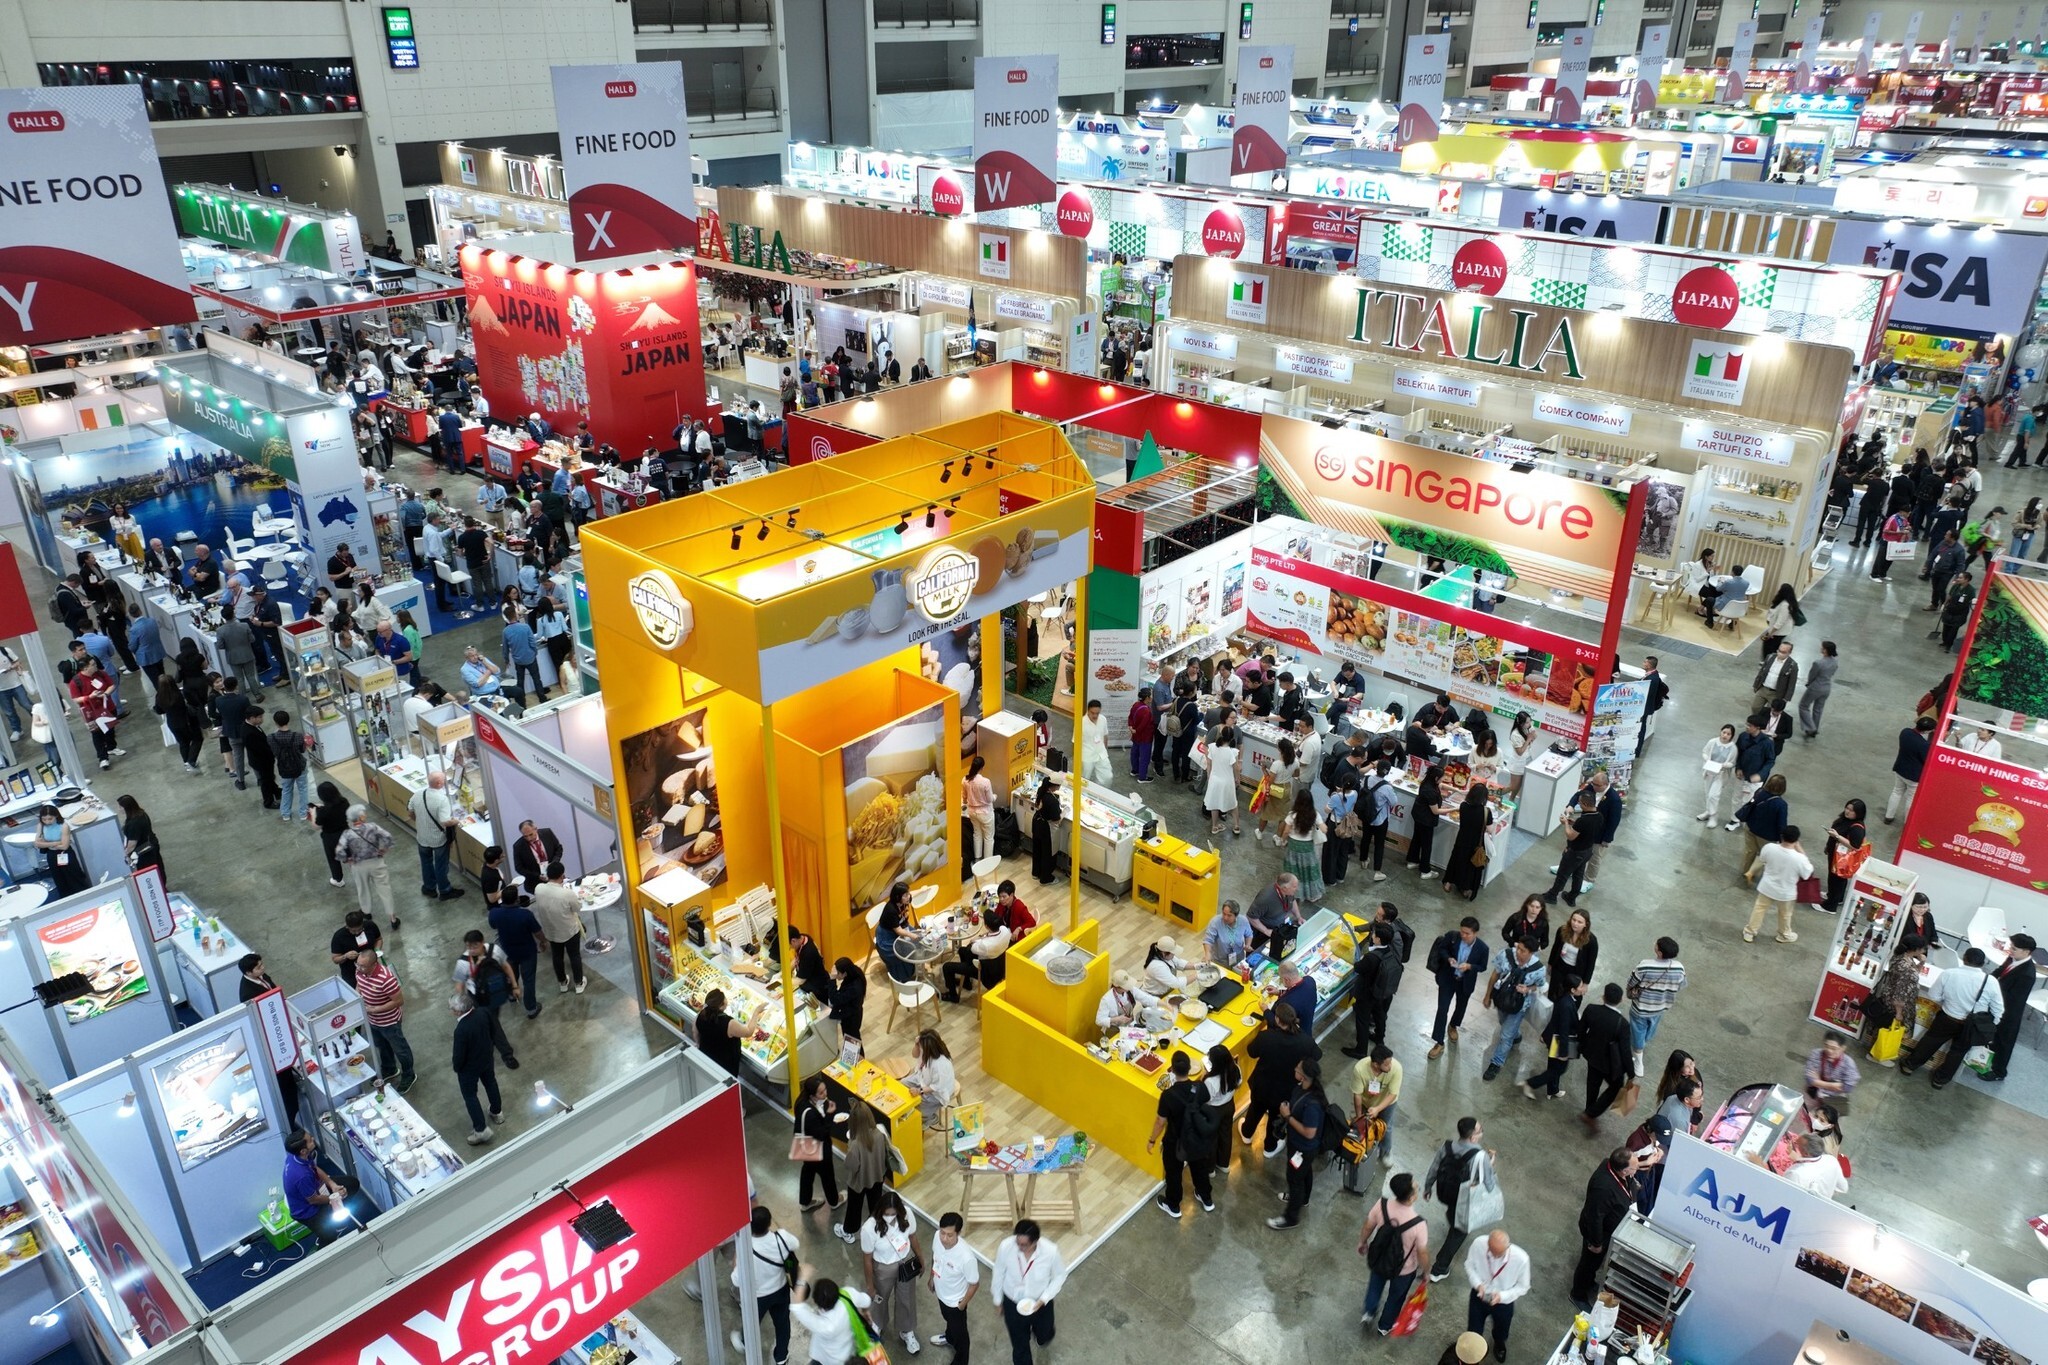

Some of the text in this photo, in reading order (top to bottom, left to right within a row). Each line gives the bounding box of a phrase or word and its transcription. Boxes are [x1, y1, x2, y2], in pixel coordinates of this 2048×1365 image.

[390, 22, 408, 31] EXIT
[1573, 61, 1587, 71] FOOD
[1008, 72, 1021, 80] HALL
[1408, 73, 1441, 86] FINE FOOD
[607, 85, 634, 95] HALL 8
[1242, 90, 1286, 105] FINE FOOD
[1913, 86, 1947, 97] Taiwn
[984, 108, 1050, 128] FINE FOOD
[1556, 100, 1563, 119] T
[14, 116, 60, 128] HALL 8
[1402, 119, 1414, 141] U
[575, 129, 676, 155] FINE FOOD
[1238, 143, 1252, 169] V
[867, 160, 911, 181] KORE
[502, 157, 569, 202] ITALI
[983, 171, 1012, 204] W
[0, 174, 143, 206] NE FOOD
[934, 192, 961, 205] JAPAN
[196, 199, 256, 244] ITALIA
[1060, 209, 1090, 223] JAPAN
[584, 210, 616, 251] X
[1312, 221, 1341, 232] GREAT
[1205, 228, 1242, 243] JAPAN
[335, 222, 354, 269] ITALIA
[696, 216, 794, 275] TALIA
[1457, 261, 1503, 279] JAPAN
[375, 280, 402, 291] MAZZA
[523, 281, 556, 301] ISLANDS
[0, 281, 37, 332] Y
[1678, 291, 1734, 310] JAPAN
[497, 294, 561, 339] JAPAN
[1000, 307, 1013, 315] PASTA
[1020, 311, 1046, 320] GRAGNANO
[652, 331, 688, 346] ISLANDS
[1348, 286, 1586, 380] ITALIA
[1184, 337, 1221, 351] NOVI S.R.L.
[622, 342, 690, 376] JAPAN
[1284, 352, 1346, 371] PASTIFICIO FRATELLI
[1301, 365, 1317, 375] LUCA
[1318, 368, 1335, 378] S.R.L.
[1396, 377, 1472, 399] SELEKTIA TARTUFI
[1690, 386, 1735, 399] ITALIAN TASTE
[194, 402, 254, 441] AUSTRALIA
[1539, 404, 1624, 427] COMEX COMPANY
[1713, 430, 1763, 447] SULPIZIO
[1696, 439, 1774, 461] TARTUFI S.R.L.
[1319, 452, 1342, 472] SG
[936, 560, 956, 570] REAL
[1254, 553, 1296, 571] HWG PTE LTD
[918, 563, 975, 597] CALIFORNIA
[933, 586, 960, 601] MILK
[632, 586, 680, 626] CALIFORNIA
[908, 629, 926, 643] LOOK
[926, 625, 939, 635] FOR
[953, 612, 971, 624] SEAL.
[1346, 647, 1375, 660] Processing
[1404, 668, 1427, 680] Peanuts
[1451, 681, 1466, 689] Halal
[1465, 686, 1485, 697] Ready
[1459, 689, 1475, 698] Meal
[1498, 696, 1523, 709] Minimally
[1498, 701, 1514, 711] Supply
[1555, 716, 1569, 724] Halal
[1560, 723, 1584, 734] Product
[1938, 753, 2048, 791] OH CHIN HING SESA
[2021, 797, 2042, 806] TASTE
[145, 877, 153, 889] BHD
[149, 889, 157, 900] SDN
[152, 900, 163, 919] FOODS
[267, 1000, 277, 1014] BHD
[271, 1013, 280, 1026] SDN
[274, 1025, 284, 1042] FOOD
[1682, 1167, 1791, 1246] AdM
[1683, 1204, 1772, 1254] Albert de Mun
[458, 1248, 640, 1365] GROUP
